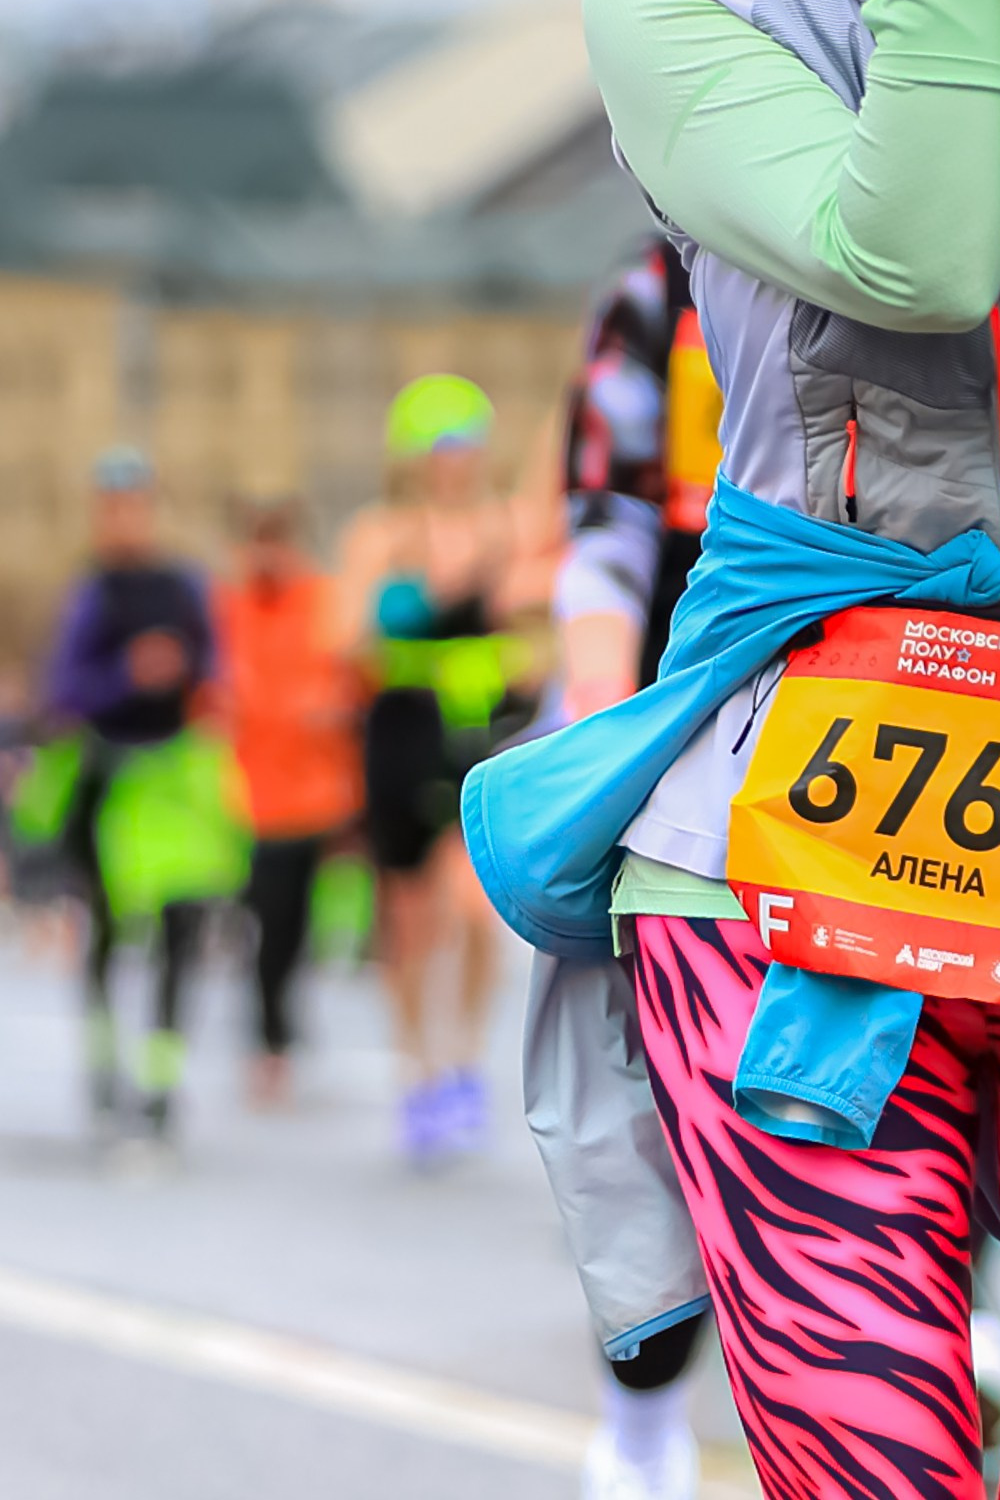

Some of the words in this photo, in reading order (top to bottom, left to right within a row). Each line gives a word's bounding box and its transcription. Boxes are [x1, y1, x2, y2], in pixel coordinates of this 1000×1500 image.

[900, 639, 956, 660] ПОЛУ
[897, 657, 996, 686] МАРАФОН
[870, 851, 986, 898] АЛЕНА
[758, 892, 794, 950] F
